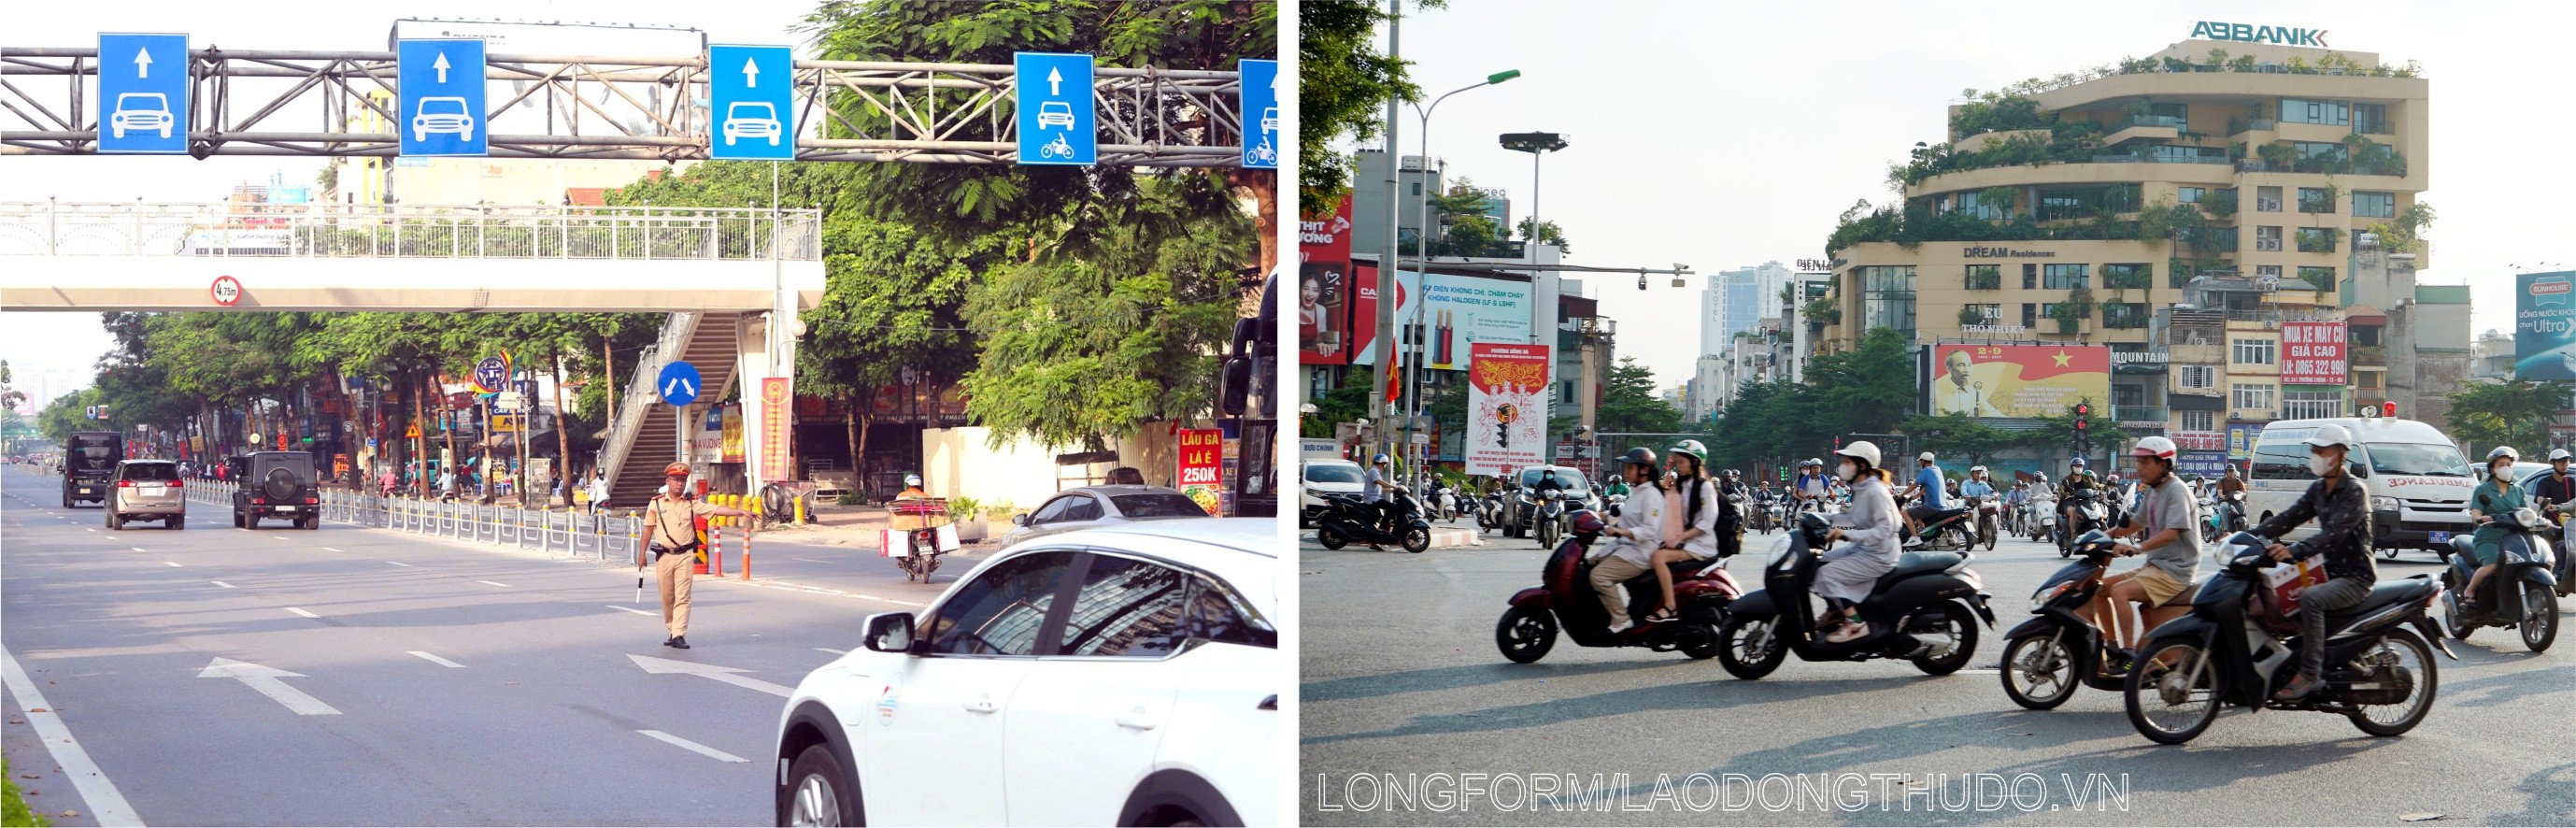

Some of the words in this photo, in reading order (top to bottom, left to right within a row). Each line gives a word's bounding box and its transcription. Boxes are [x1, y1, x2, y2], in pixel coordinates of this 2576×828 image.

[2191, 21, 2321, 46] ABBANK
[1964, 248, 2008, 258] DREAM
[2010, 250, 2056, 258] Residences
[2533, 284, 2568, 293] SUNHOUSE
[1452, 296, 1480, 305] HALOGEN
[1985, 307, 2003, 319] EU
[2519, 309, 2538, 318] UỐNG
[2538, 309, 2557, 318] NƯỚC
[1962, 319, 1985, 333] THỔ
[2284, 325, 2301, 343] MUA
[2302, 325, 2313, 343] XE
[2314, 322, 2331, 343] MÁY
[2334, 322, 2344, 343] CŨ
[1977, 347, 2002, 355] 2-9
[2291, 343, 2311, 357] GIÁ
[2313, 345, 2336, 357] CAO
[2112, 351, 2169, 363] MOUNTAIN
[2283, 360, 2294, 375] LH:
[2296, 360, 2313, 375] 0865
[2315, 360, 2329, 375] 322
[2331, 360, 2344, 375] 998
[1204, 432, 1219, 446] GÀ
[1316, 443, 1334, 452] CHÍNH
[1189, 450, 1203, 464] LÁ
[1183, 467, 1217, 482] 250K
